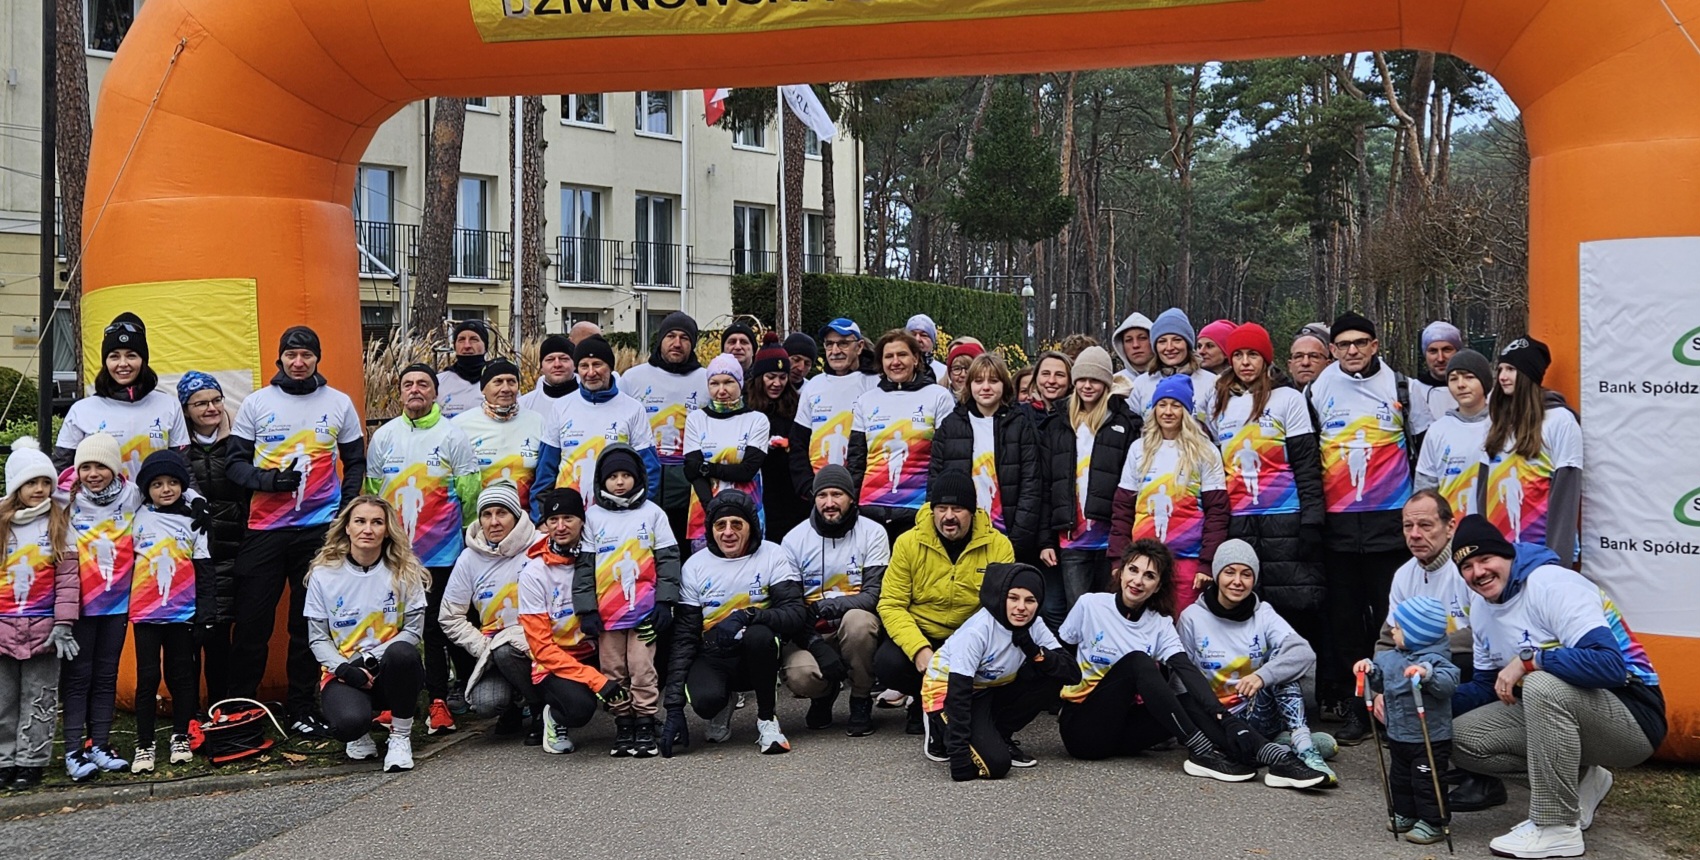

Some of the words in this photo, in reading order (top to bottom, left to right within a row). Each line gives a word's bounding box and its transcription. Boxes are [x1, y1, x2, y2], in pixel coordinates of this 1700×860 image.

[1599, 380, 1637, 394] Bank
[1641, 380, 1699, 397] Spółdz
[1376, 413, 1391, 421] DLB
[1600, 536, 1638, 552] Bank
[1642, 539, 1700, 556] Spółdz
